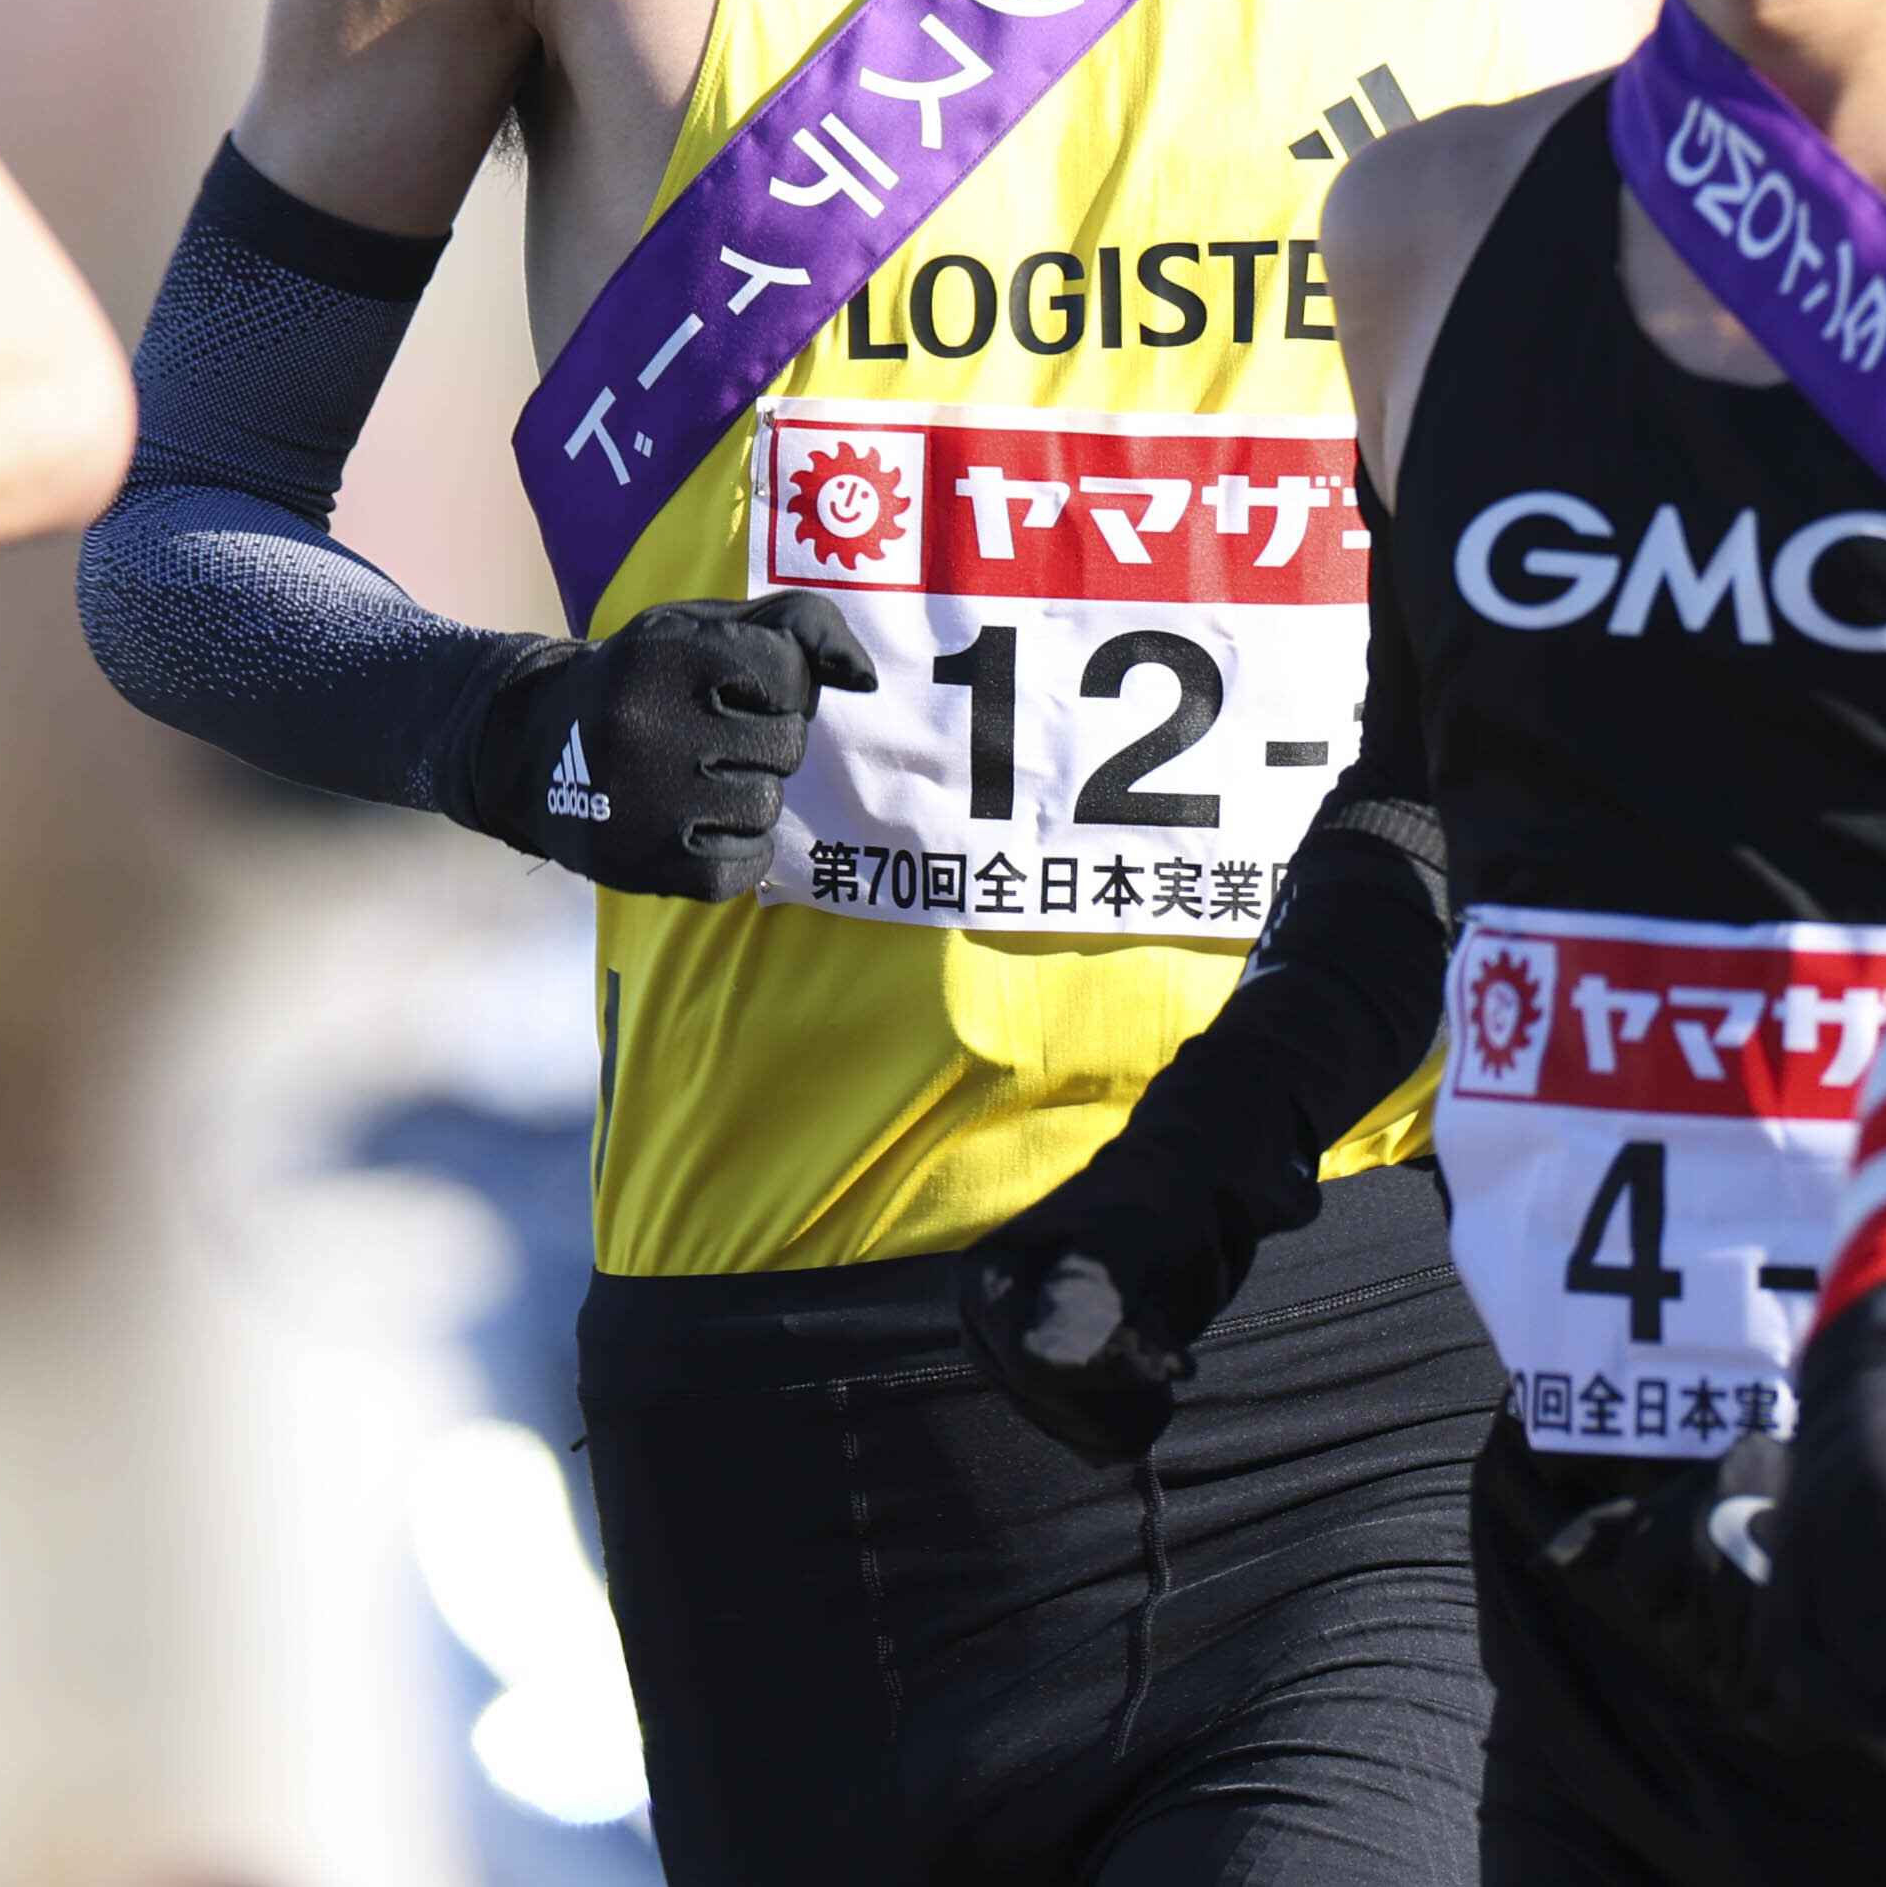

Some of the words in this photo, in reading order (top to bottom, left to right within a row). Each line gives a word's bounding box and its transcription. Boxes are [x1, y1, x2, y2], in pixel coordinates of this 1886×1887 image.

[954, 464, 1369, 568] ヤマザ
[931, 624, 1364, 830] 12-
[547, 781, 611, 822] adidas
